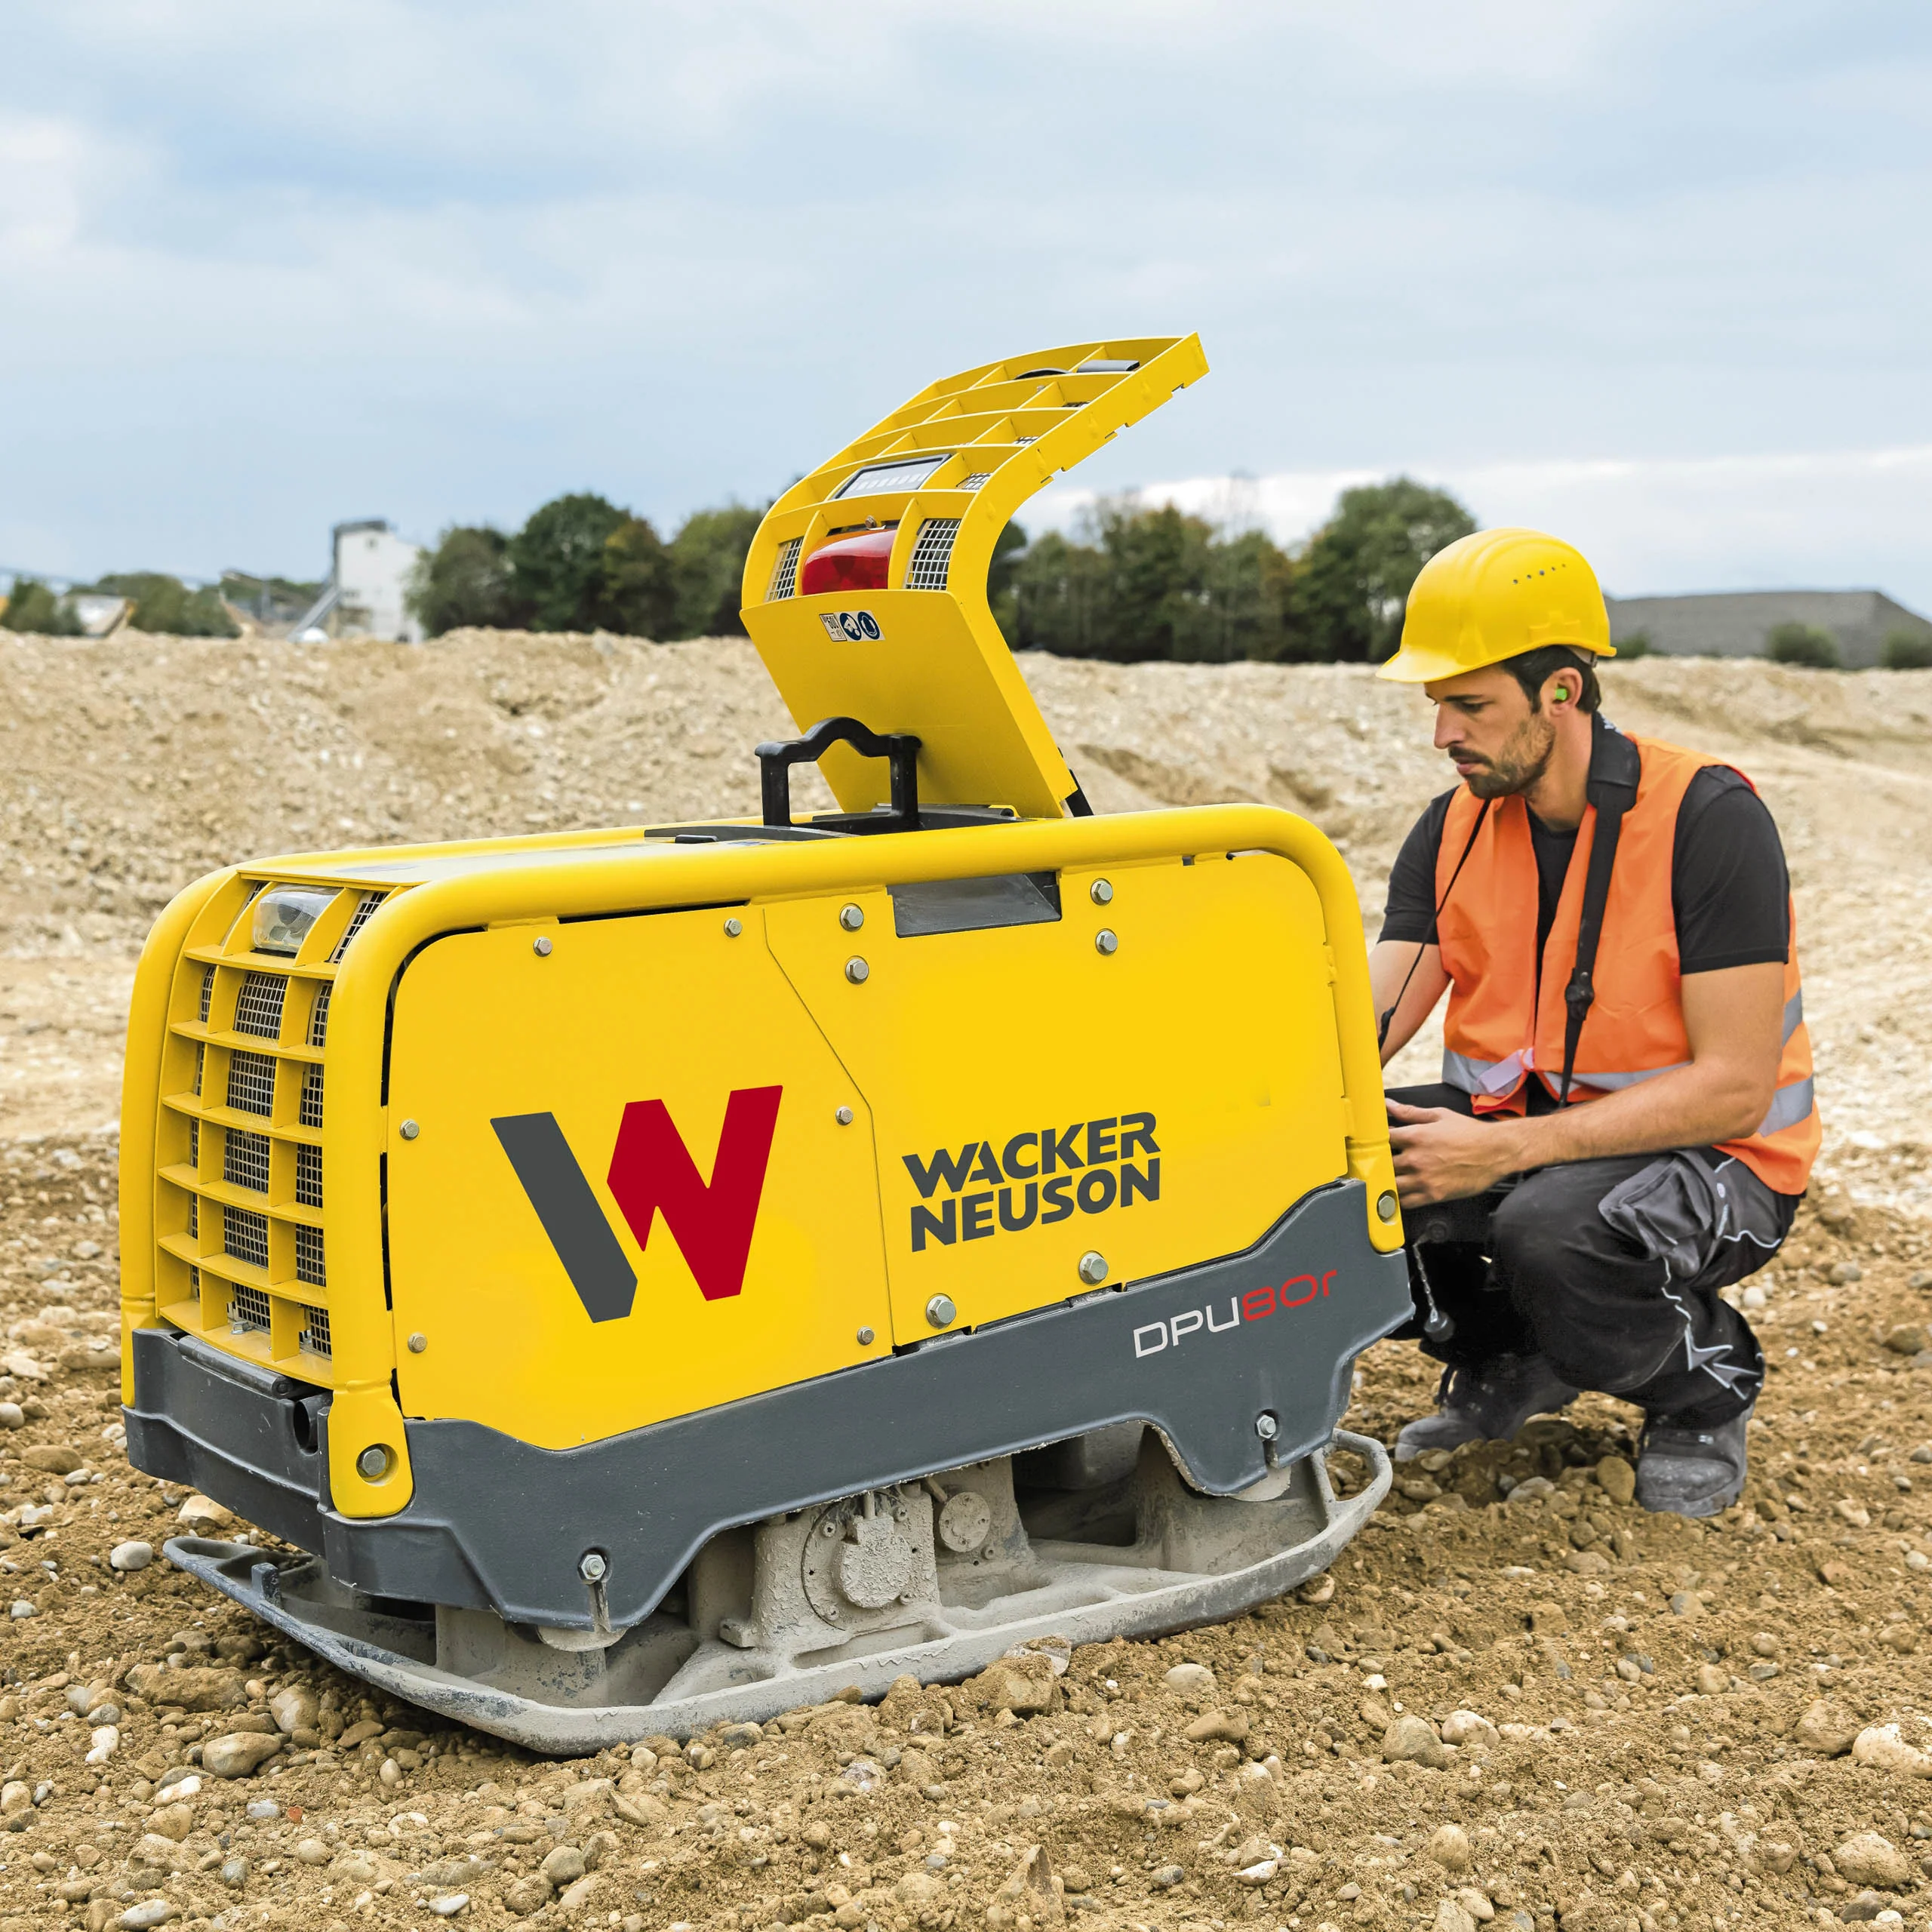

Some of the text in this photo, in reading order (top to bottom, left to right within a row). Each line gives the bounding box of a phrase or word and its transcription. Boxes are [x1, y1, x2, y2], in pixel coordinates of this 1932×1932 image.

[901, 1112, 1161, 1199] WACKER
[910, 1157, 1161, 1253] NEUSON
[1134, 1269, 1338, 1358] DPU80r
